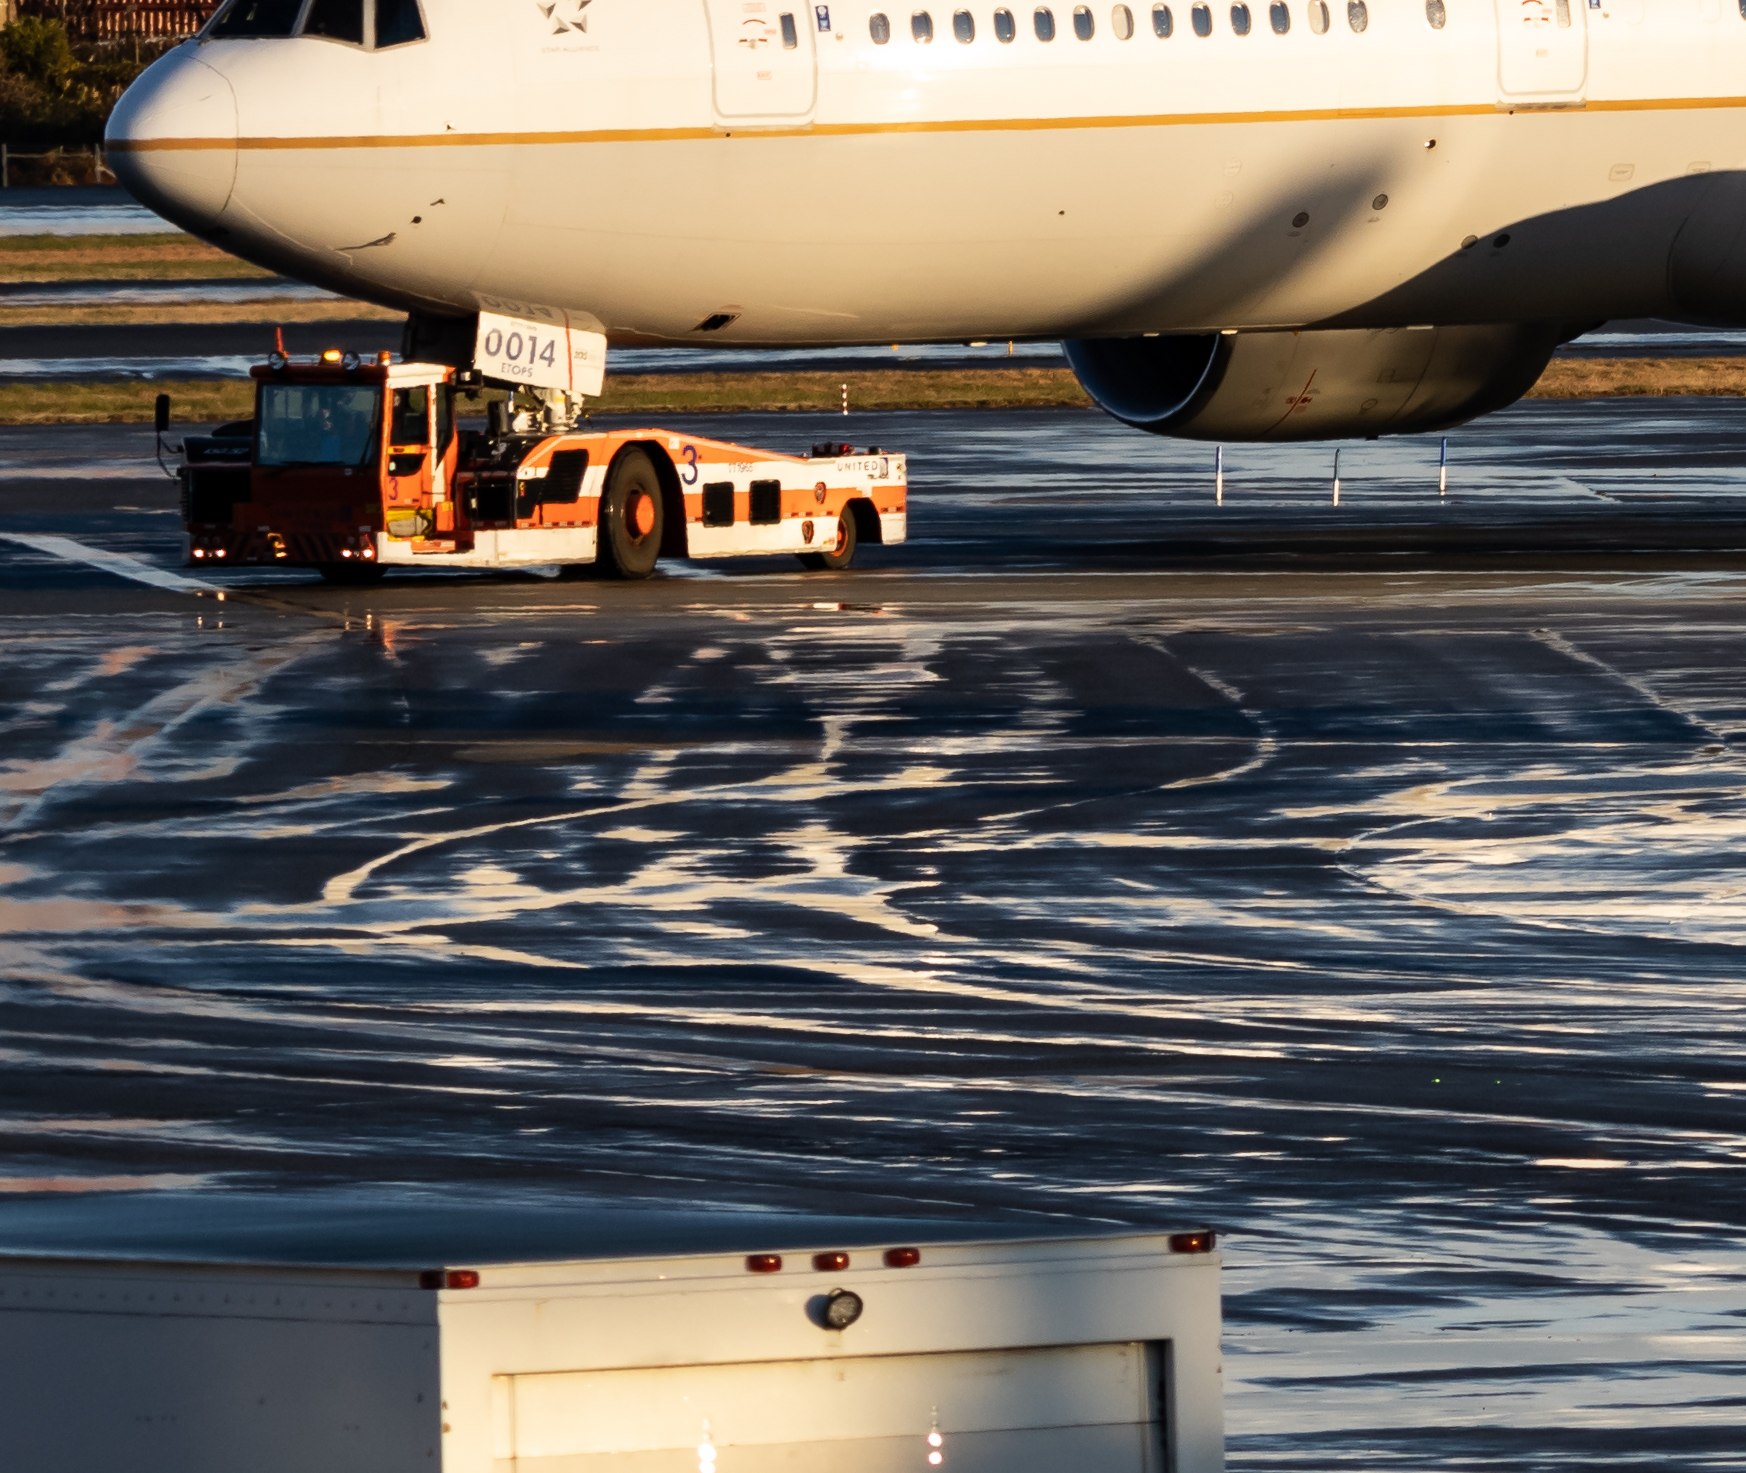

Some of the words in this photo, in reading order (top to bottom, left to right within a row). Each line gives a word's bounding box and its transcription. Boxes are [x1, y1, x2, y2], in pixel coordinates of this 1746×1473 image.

[485, 328, 556, 368] 0014
[501, 362, 533, 378] ETOPS
[681, 444, 698, 485] 3
[837, 461, 879, 473] UNITED
[388, 477, 399, 501] 3
